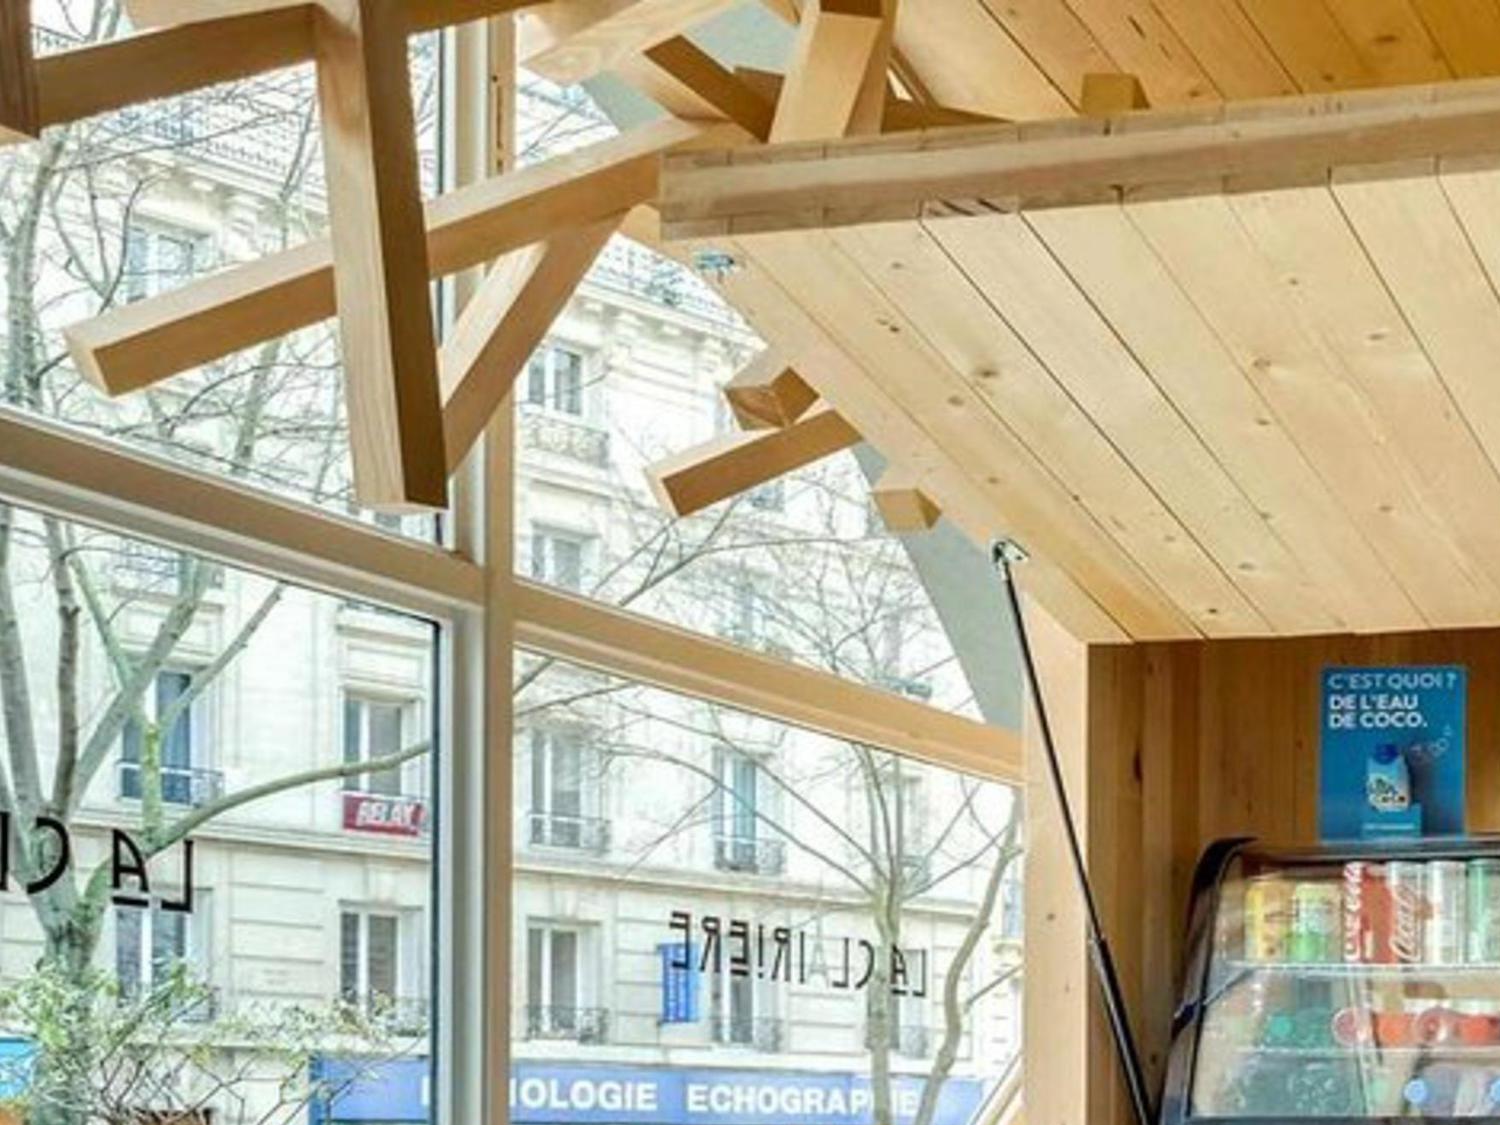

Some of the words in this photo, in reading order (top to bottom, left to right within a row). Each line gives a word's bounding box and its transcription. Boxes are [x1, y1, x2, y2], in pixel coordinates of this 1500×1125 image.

[1328, 673, 1384, 689] C'EST
[1387, 672, 1443, 689] QUOI
[1329, 694, 1356, 710] DE
[1359, 694, 1419, 710] L'EAU
[1329, 712, 1356, 729] DE
[1359, 712, 1428, 729] COCO.
[686, 1083, 919, 1116] ECHOGRAPIE
